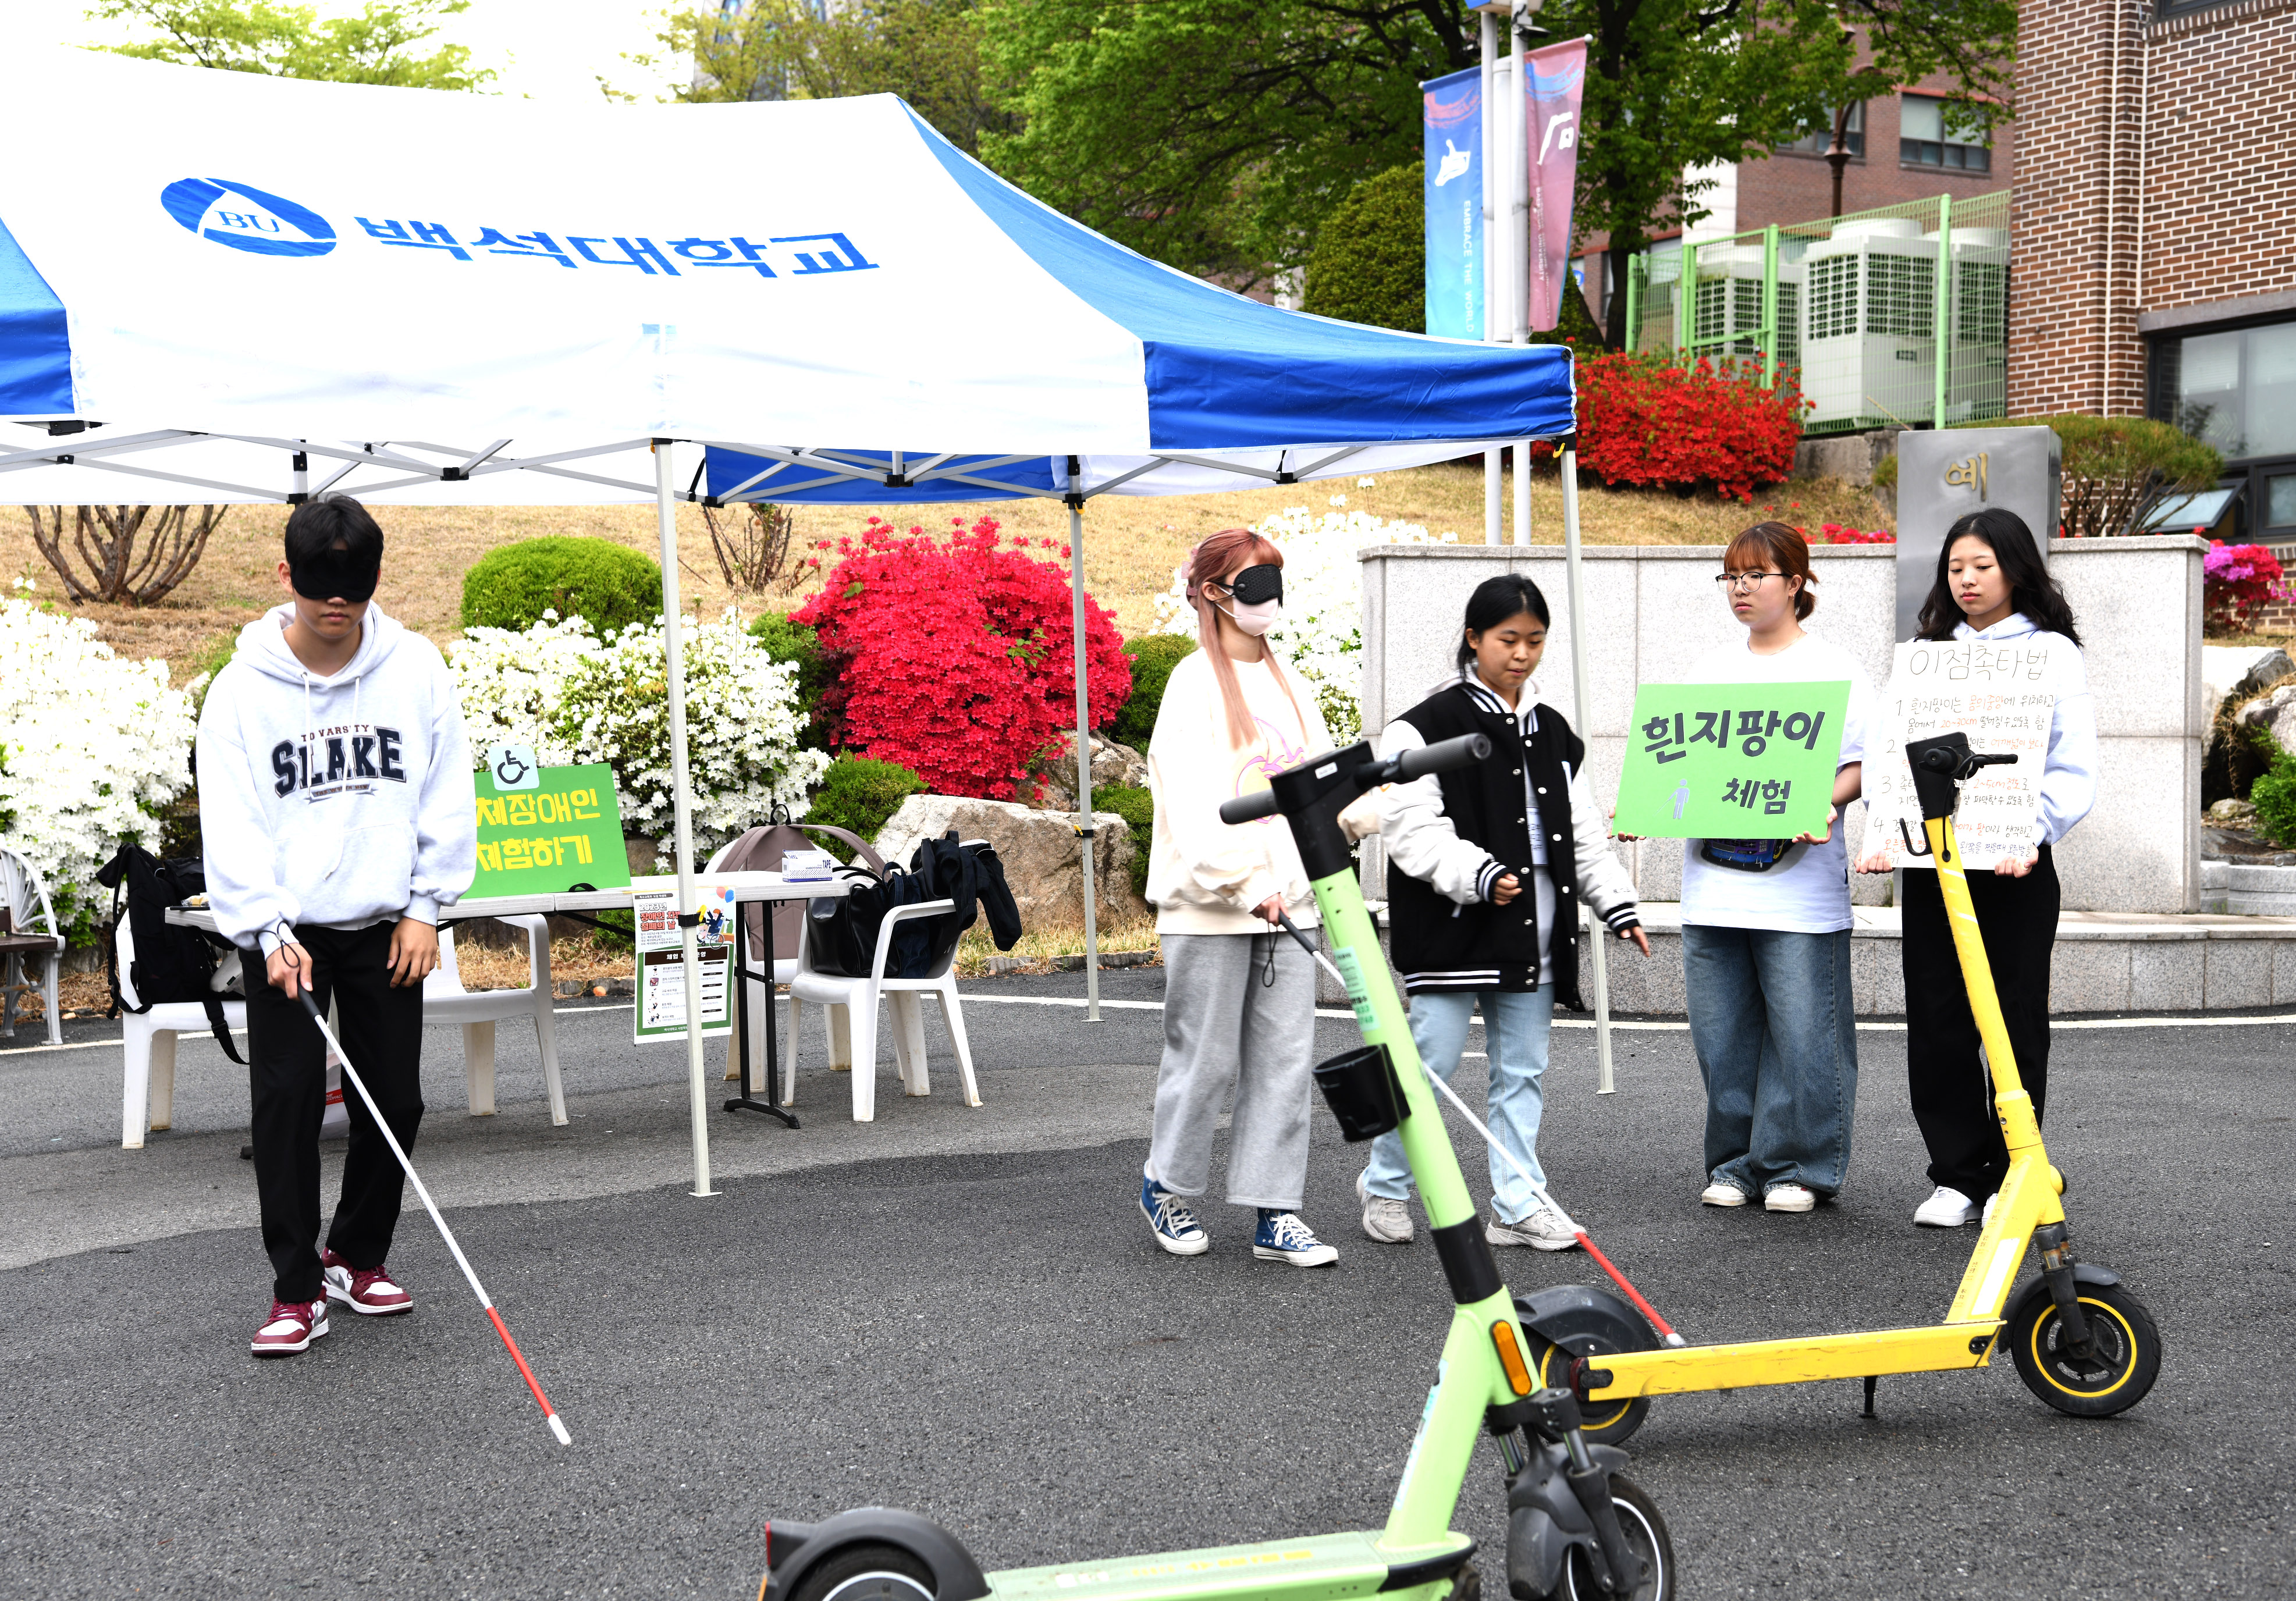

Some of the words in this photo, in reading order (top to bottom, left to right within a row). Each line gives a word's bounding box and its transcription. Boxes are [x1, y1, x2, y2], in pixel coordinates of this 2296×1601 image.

[214, 209, 282, 233] BU
[1463, 200, 1473, 257] EMBRACE
[354, 216, 880, 279] 백석대학교
[1464, 263, 1473, 285] THE
[1465, 290, 1474, 333] WORLD
[1945, 452, 1988, 502] 예
[1910, 643, 2048, 681] 이점촉타법
[1910, 696, 1961, 714] 흰지팡이는
[2020, 694, 2054, 708] 위치하고
[318, 724, 369, 737] VARSTY
[1641, 709, 1825, 764] 흰지팡이
[1908, 717, 1935, 734] 몸에서
[1939, 718, 1977, 729] 20~30cm
[271, 725, 407, 799] SLAKE
[1721, 777, 1792, 815] 체험
[2005, 825, 2033, 838] 생각하고
[476, 834, 593, 871] 체험하기
[823, 860, 831, 869] TAPE
[639, 902, 667, 911] 2023년
[640, 912, 664, 921] 장애인
[640, 921, 665, 931] 철폐의
[667, 920, 676, 929] 날
